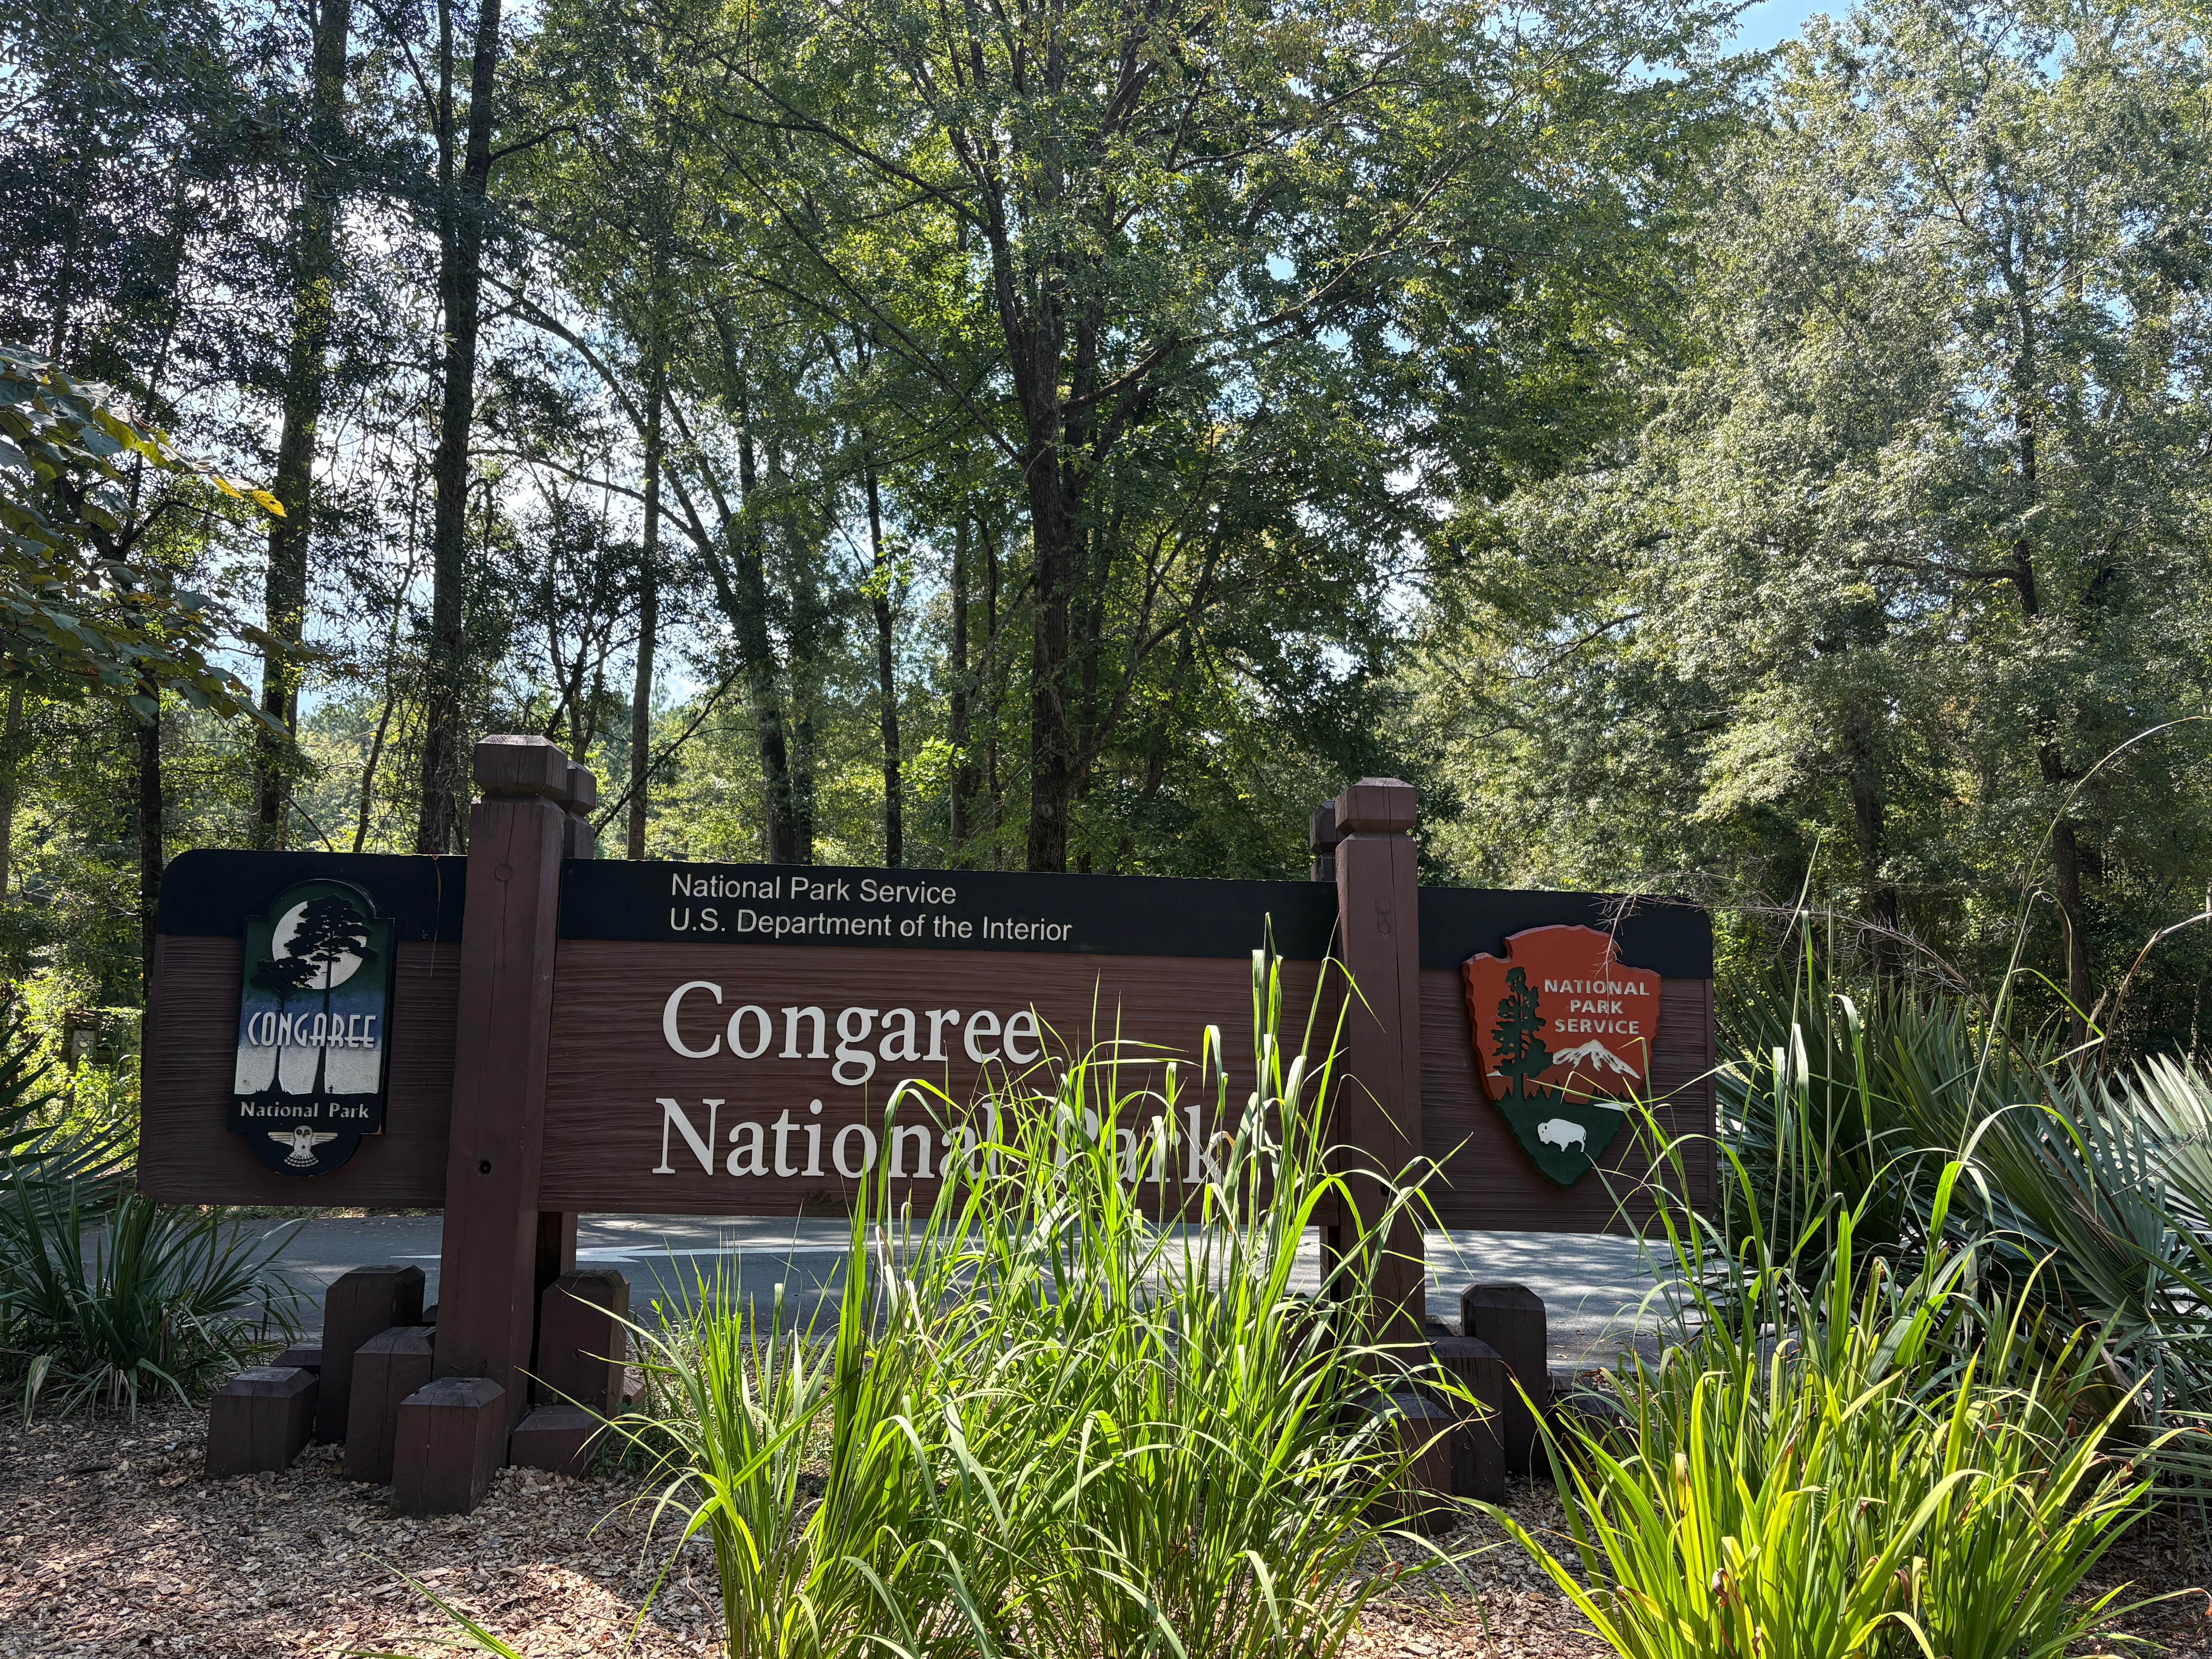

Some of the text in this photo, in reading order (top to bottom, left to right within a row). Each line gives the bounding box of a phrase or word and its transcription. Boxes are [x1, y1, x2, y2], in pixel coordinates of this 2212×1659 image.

[672, 873, 957, 905] National Park Service
[670, 907, 1073, 941] U.S. Department of the Interior
[1544, 979, 1650, 996] NATIONAL
[1570, 999, 1624, 1015] PARK
[247, 1012, 377, 1048] CONGAREE
[663, 981, 1041, 1086] Congaree
[1554, 1018, 1640, 1035] SERVICE
[240, 1101, 370, 1118] National Park
[652, 1097, 1005, 1180] National
